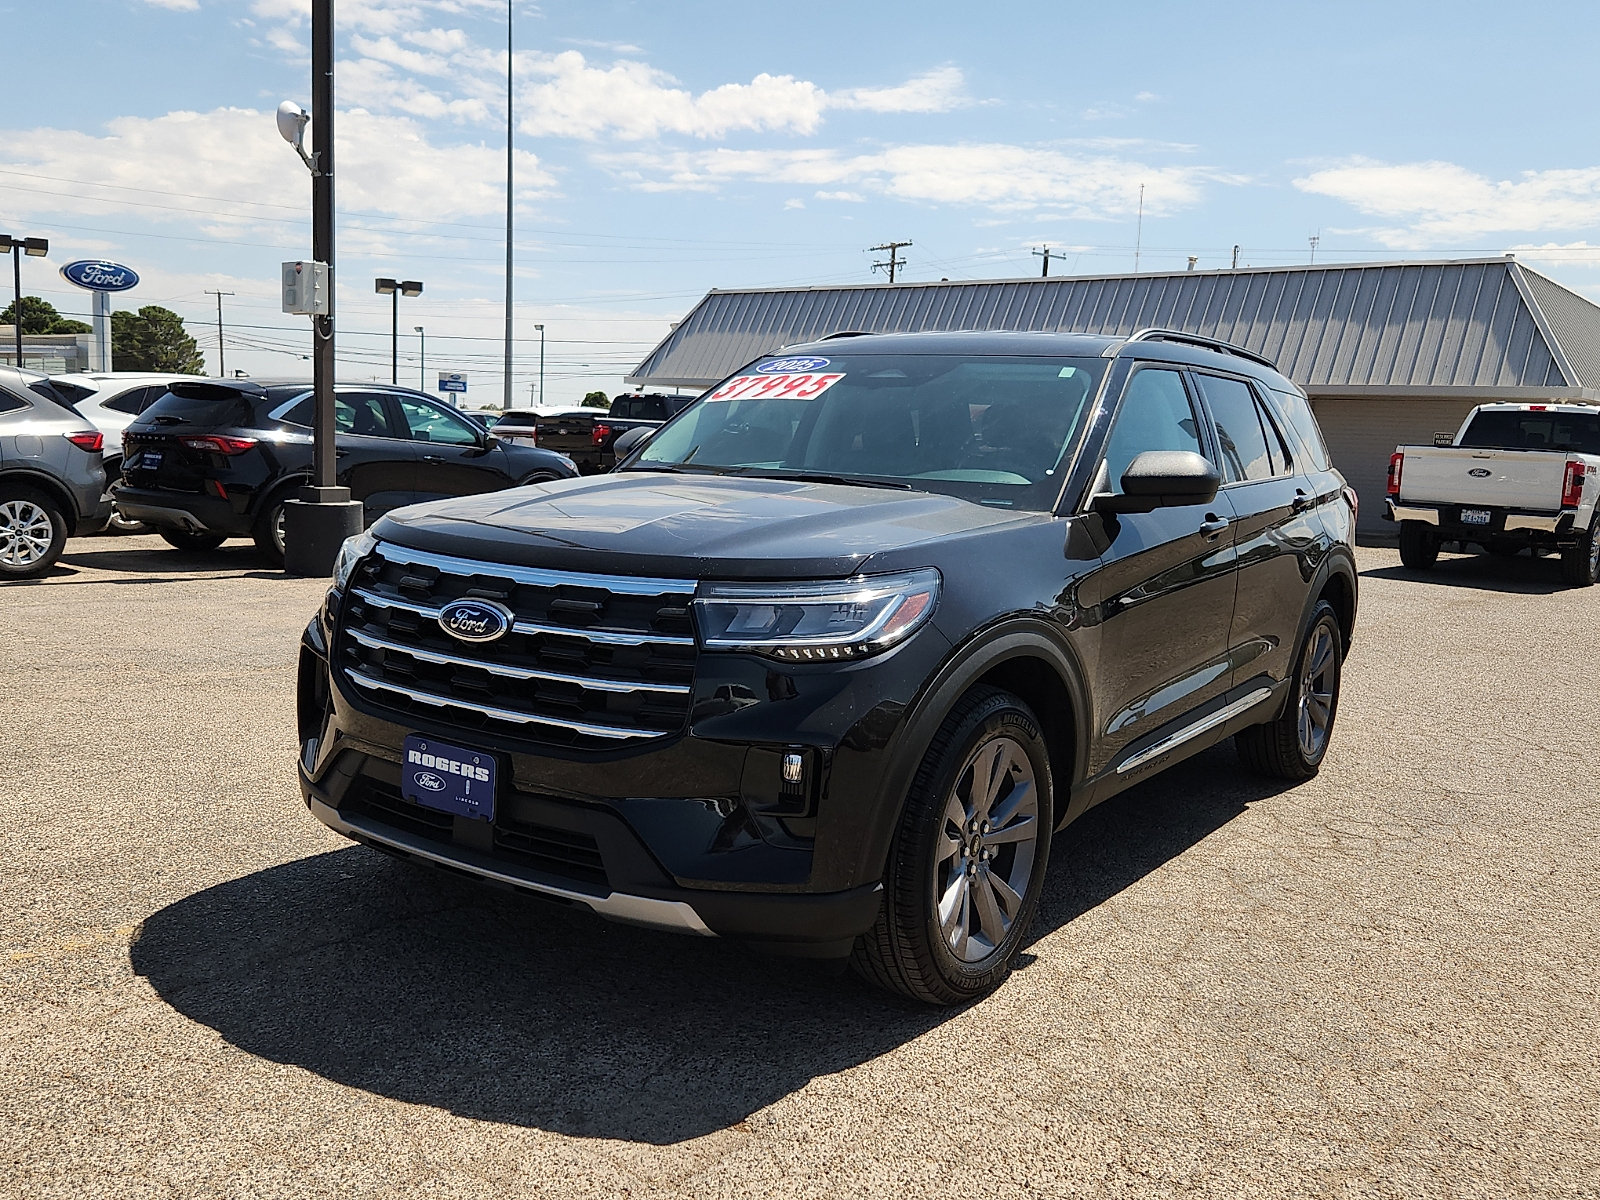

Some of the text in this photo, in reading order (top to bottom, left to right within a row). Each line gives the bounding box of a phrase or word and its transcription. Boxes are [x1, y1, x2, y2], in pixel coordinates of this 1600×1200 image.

[80, 264, 126, 287] Ford
[767, 359, 822, 372] 2025
[711, 374, 841, 400] 37995
[1471, 469, 1488, 477] Ford
[450, 608, 489, 634] Ford
[1003, 713, 1037, 739] MICHELIN
[408, 749, 490, 782] ROGERS
[418, 773, 441, 790] Ford
